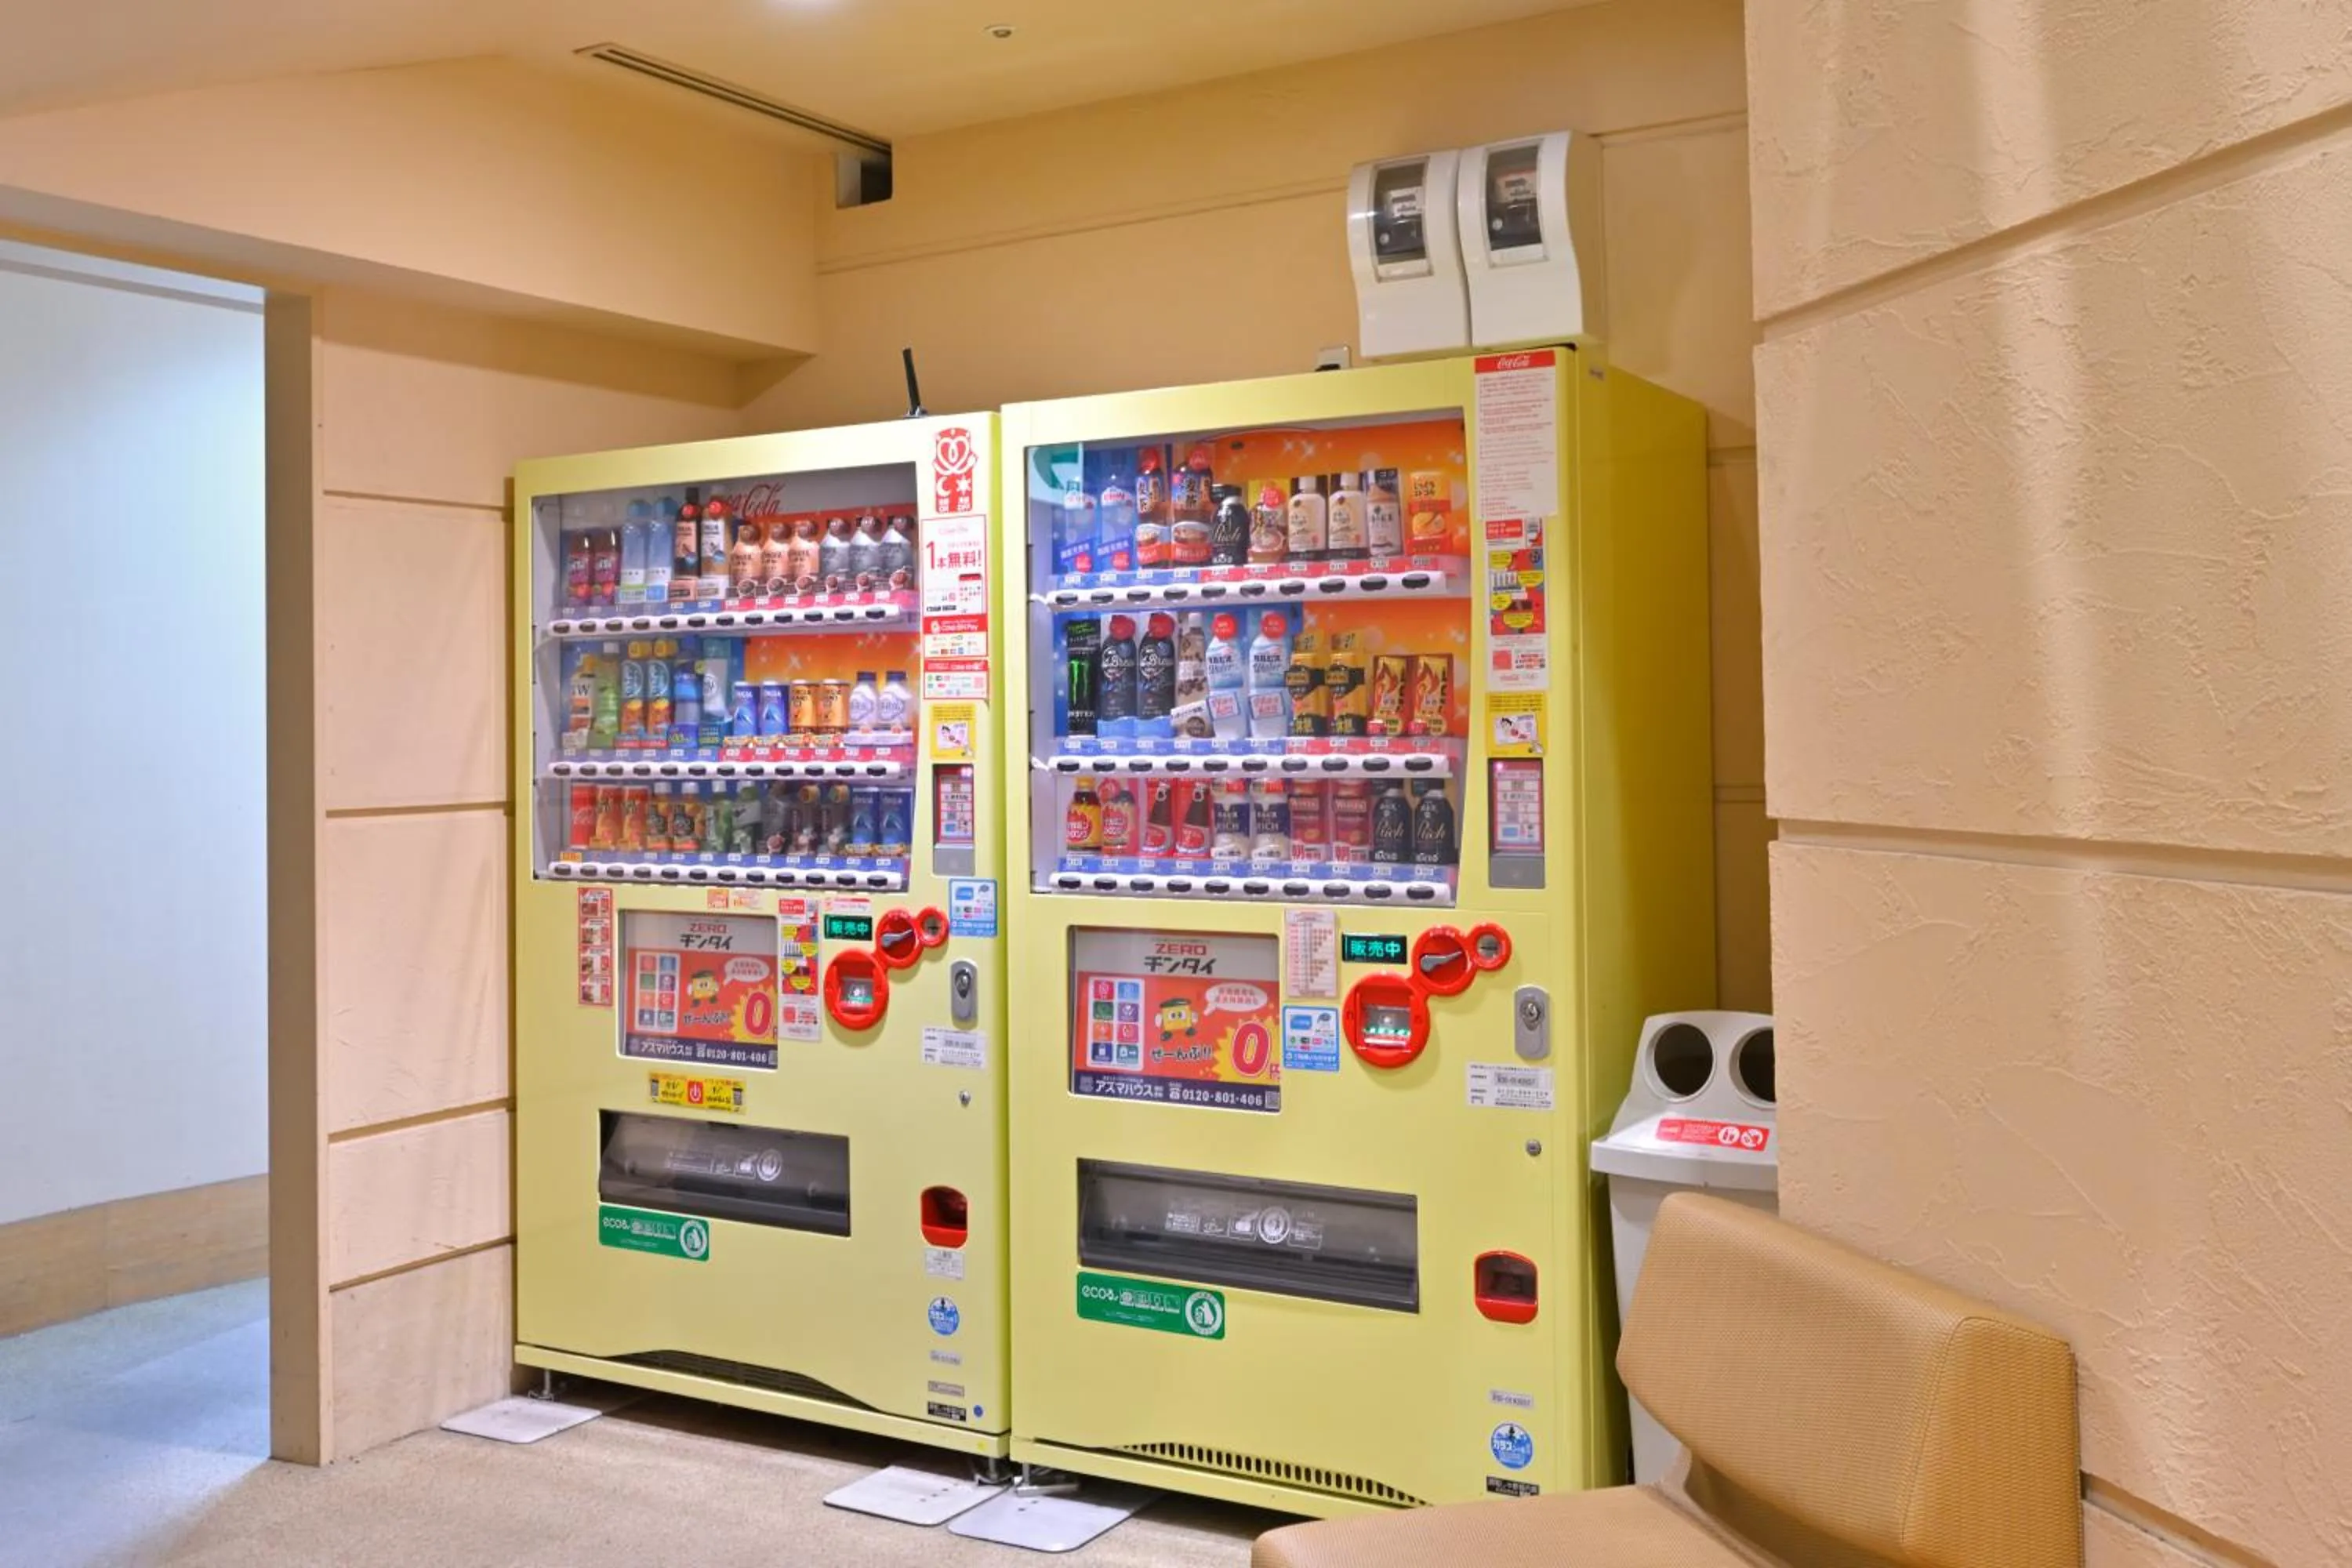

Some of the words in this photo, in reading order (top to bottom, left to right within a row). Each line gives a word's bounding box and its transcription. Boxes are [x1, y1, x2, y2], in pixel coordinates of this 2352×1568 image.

[689, 922, 727, 934] ZERO
[680, 933, 733, 950] チンタイ
[1155, 943, 1207, 956] ZERO
[1350, 940, 1402, 958] 販売中
[1144, 956, 1217, 975] チンタイ
